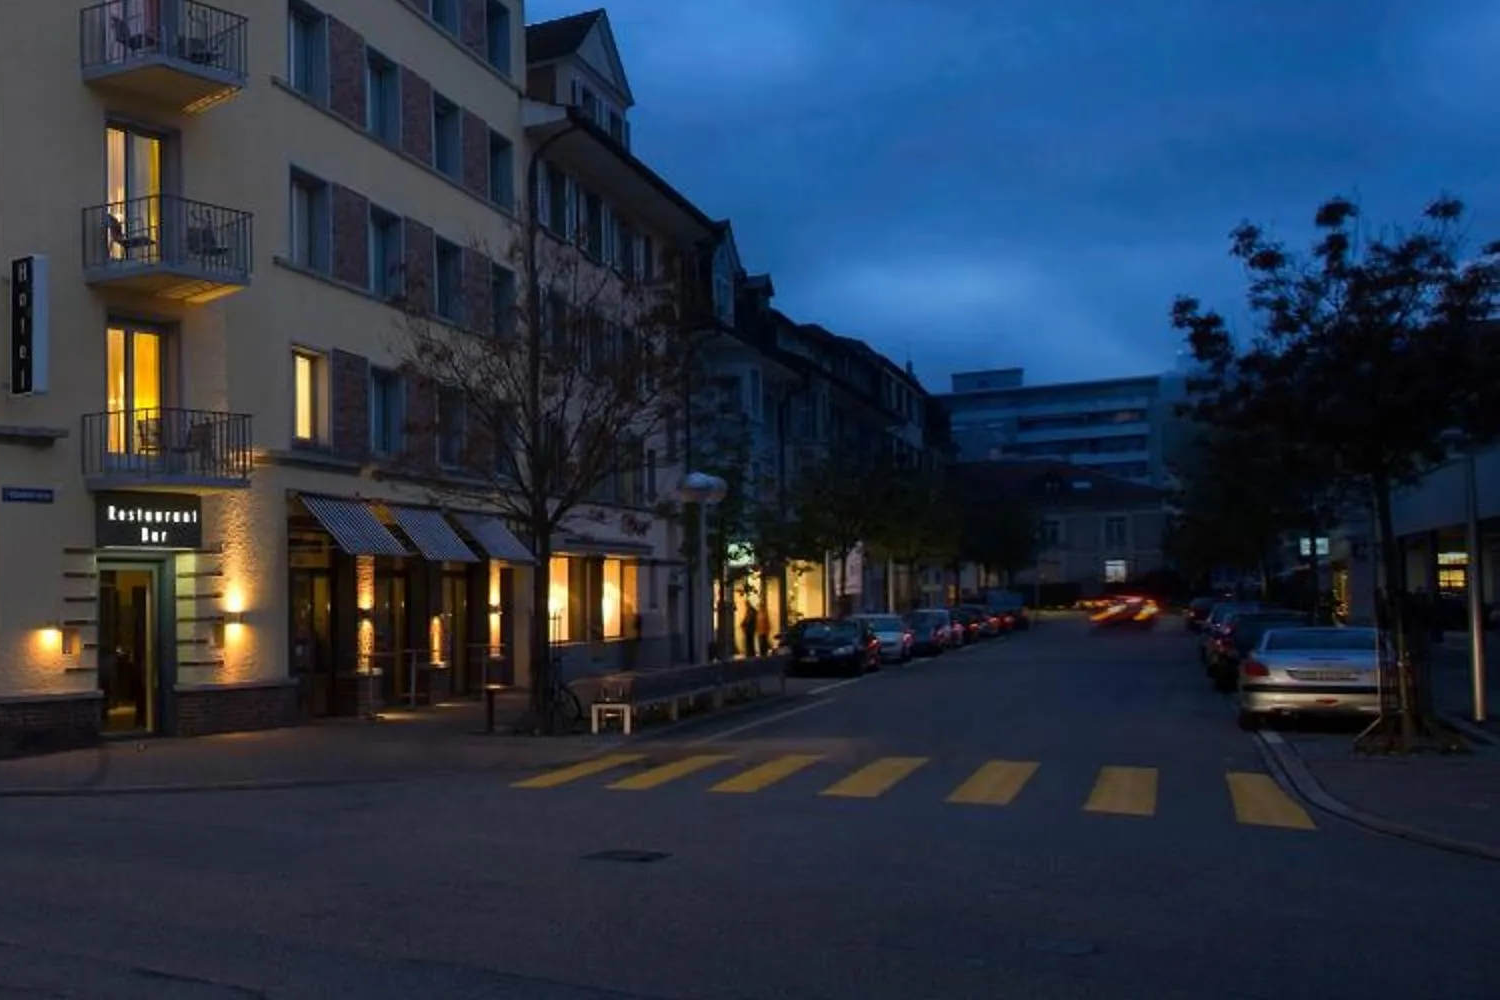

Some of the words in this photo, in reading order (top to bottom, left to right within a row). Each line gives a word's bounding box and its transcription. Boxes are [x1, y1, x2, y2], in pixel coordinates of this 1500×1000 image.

[17, 260, 28, 390] Hotel
[107, 504, 198, 524] Restaurant
[140, 526, 167, 543] Bar
